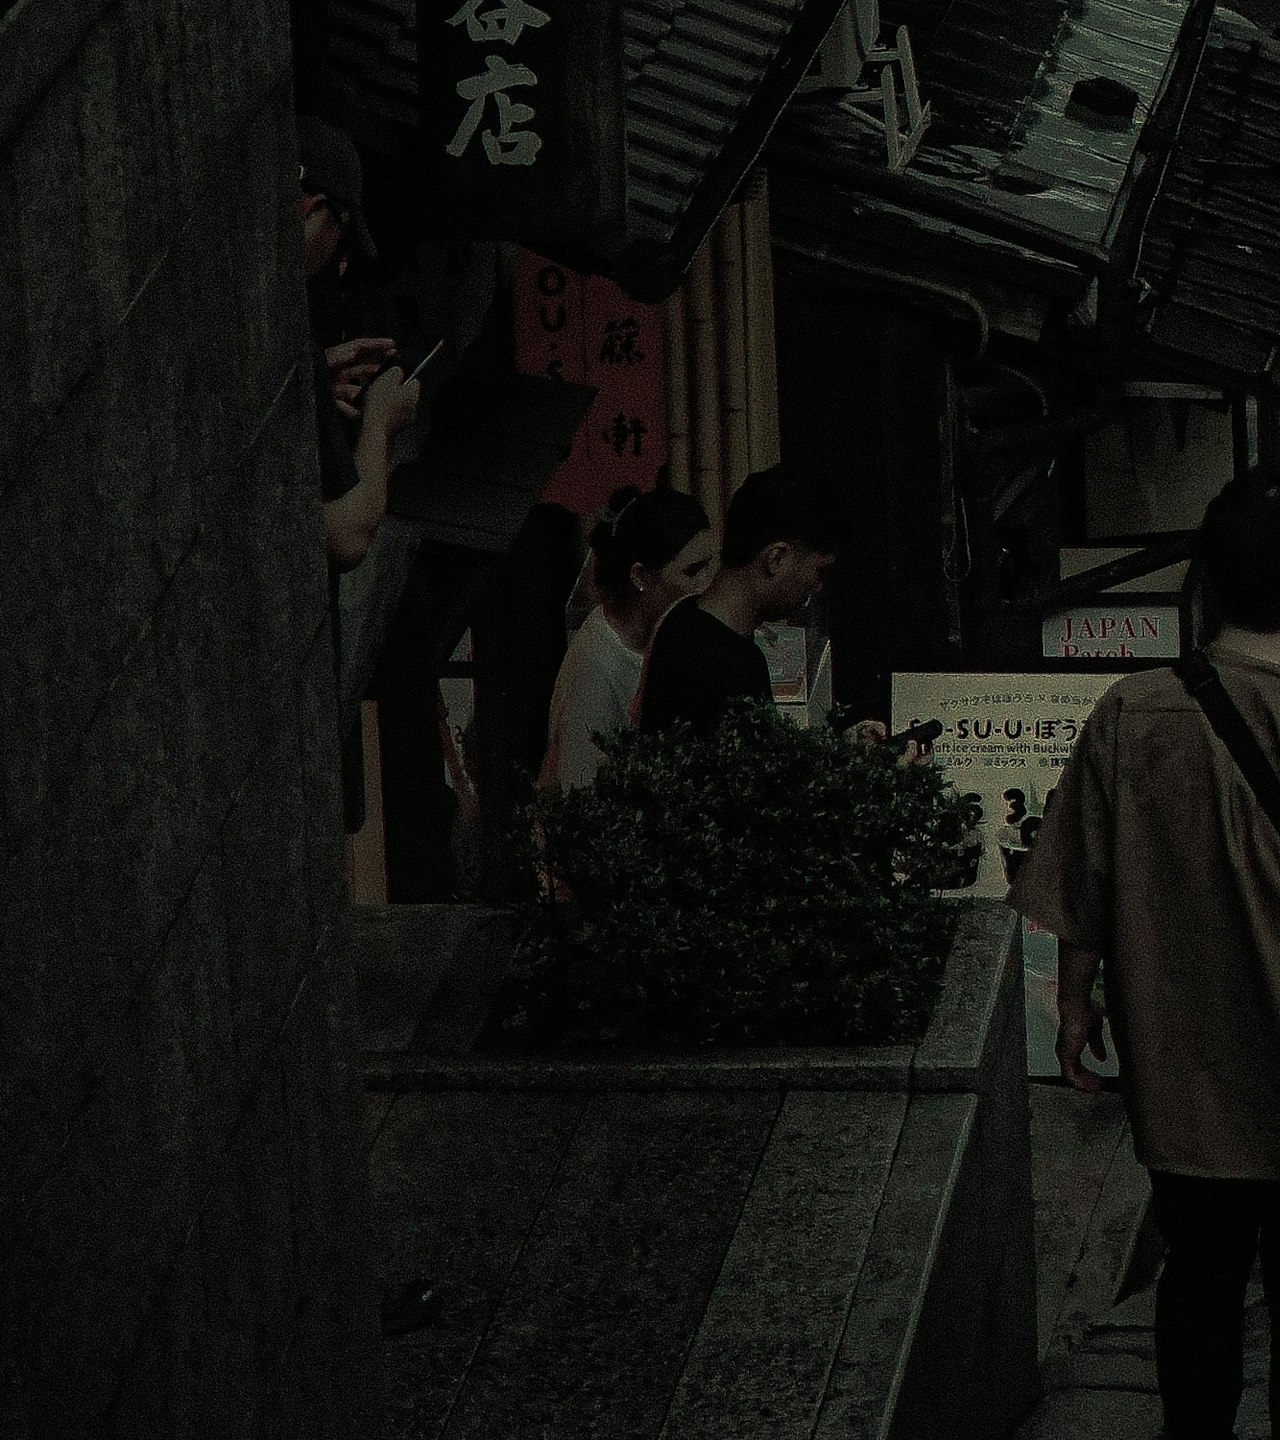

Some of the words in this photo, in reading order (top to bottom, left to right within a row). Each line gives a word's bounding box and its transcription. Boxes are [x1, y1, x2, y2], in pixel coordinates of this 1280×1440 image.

[1061, 617, 1160, 642] JAPAN
[970, 745, 1004, 754] cream
[1007, 743, 1031, 753] with
